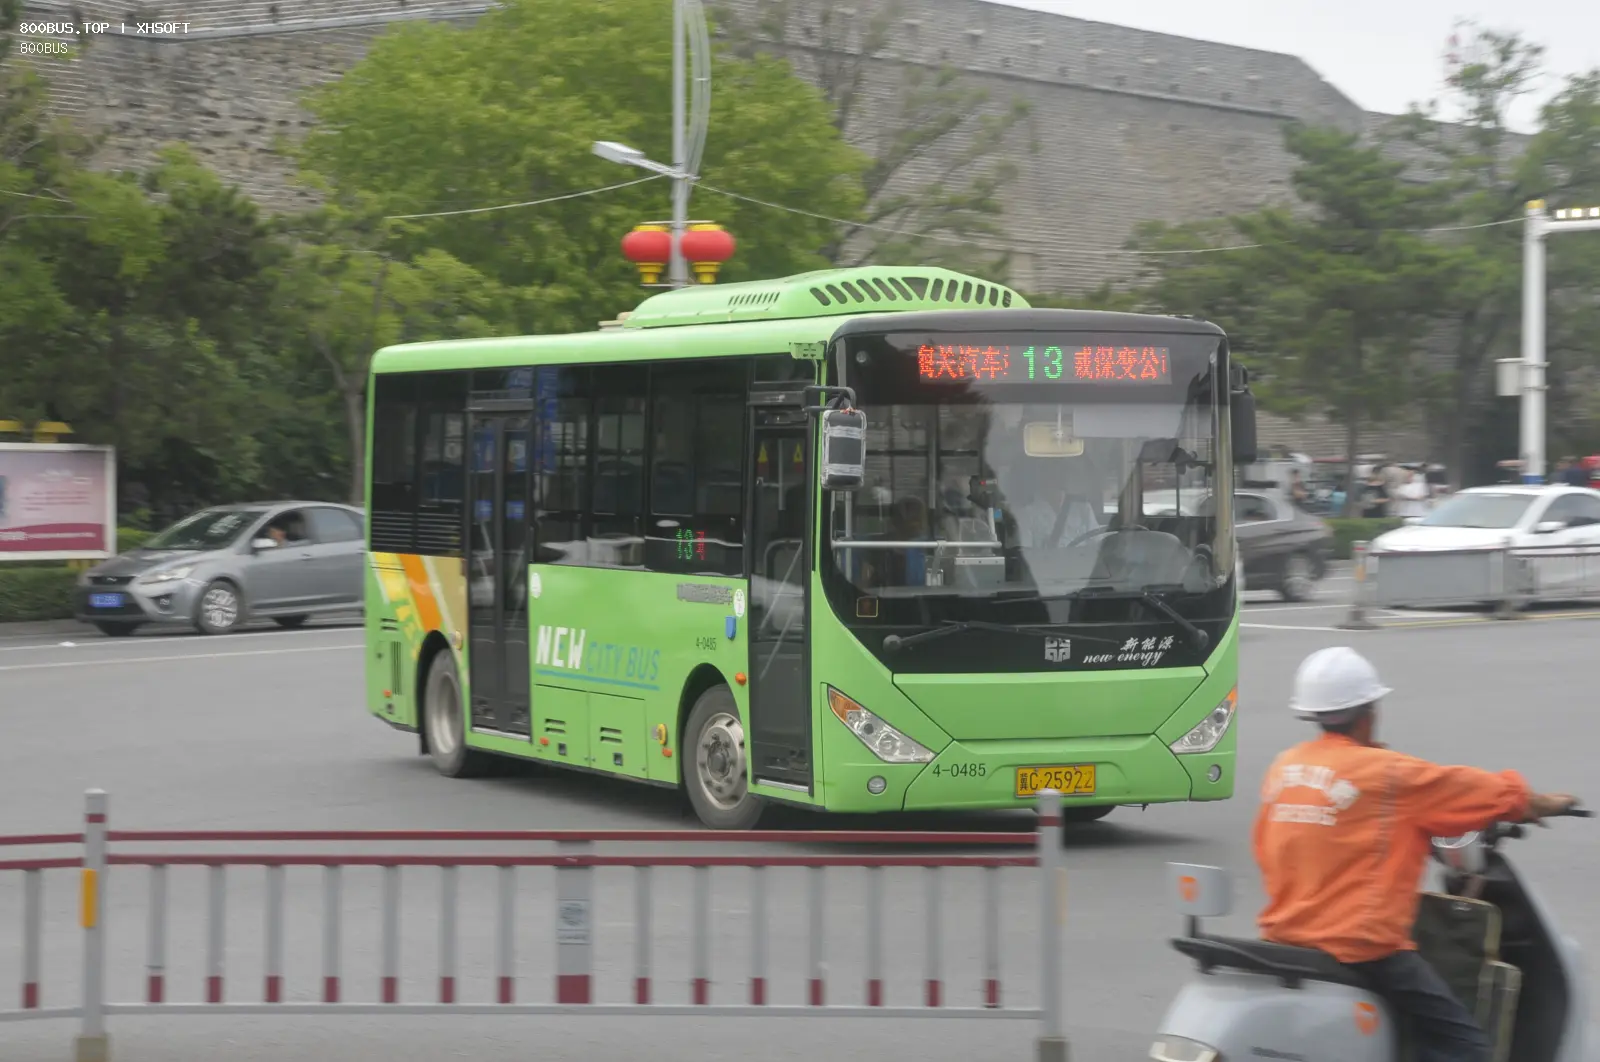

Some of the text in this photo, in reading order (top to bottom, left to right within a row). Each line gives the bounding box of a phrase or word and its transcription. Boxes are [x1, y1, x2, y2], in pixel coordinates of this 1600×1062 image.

[1022, 346, 1063, 379] 13
[696, 636, 717, 651] 4-0485
[1120, 635, 1175, 652] 新能源
[535, 625, 661, 681] NEW CITY BUS
[1083, 651, 1165, 667] new energy
[932, 763, 986, 777] 4-0485
